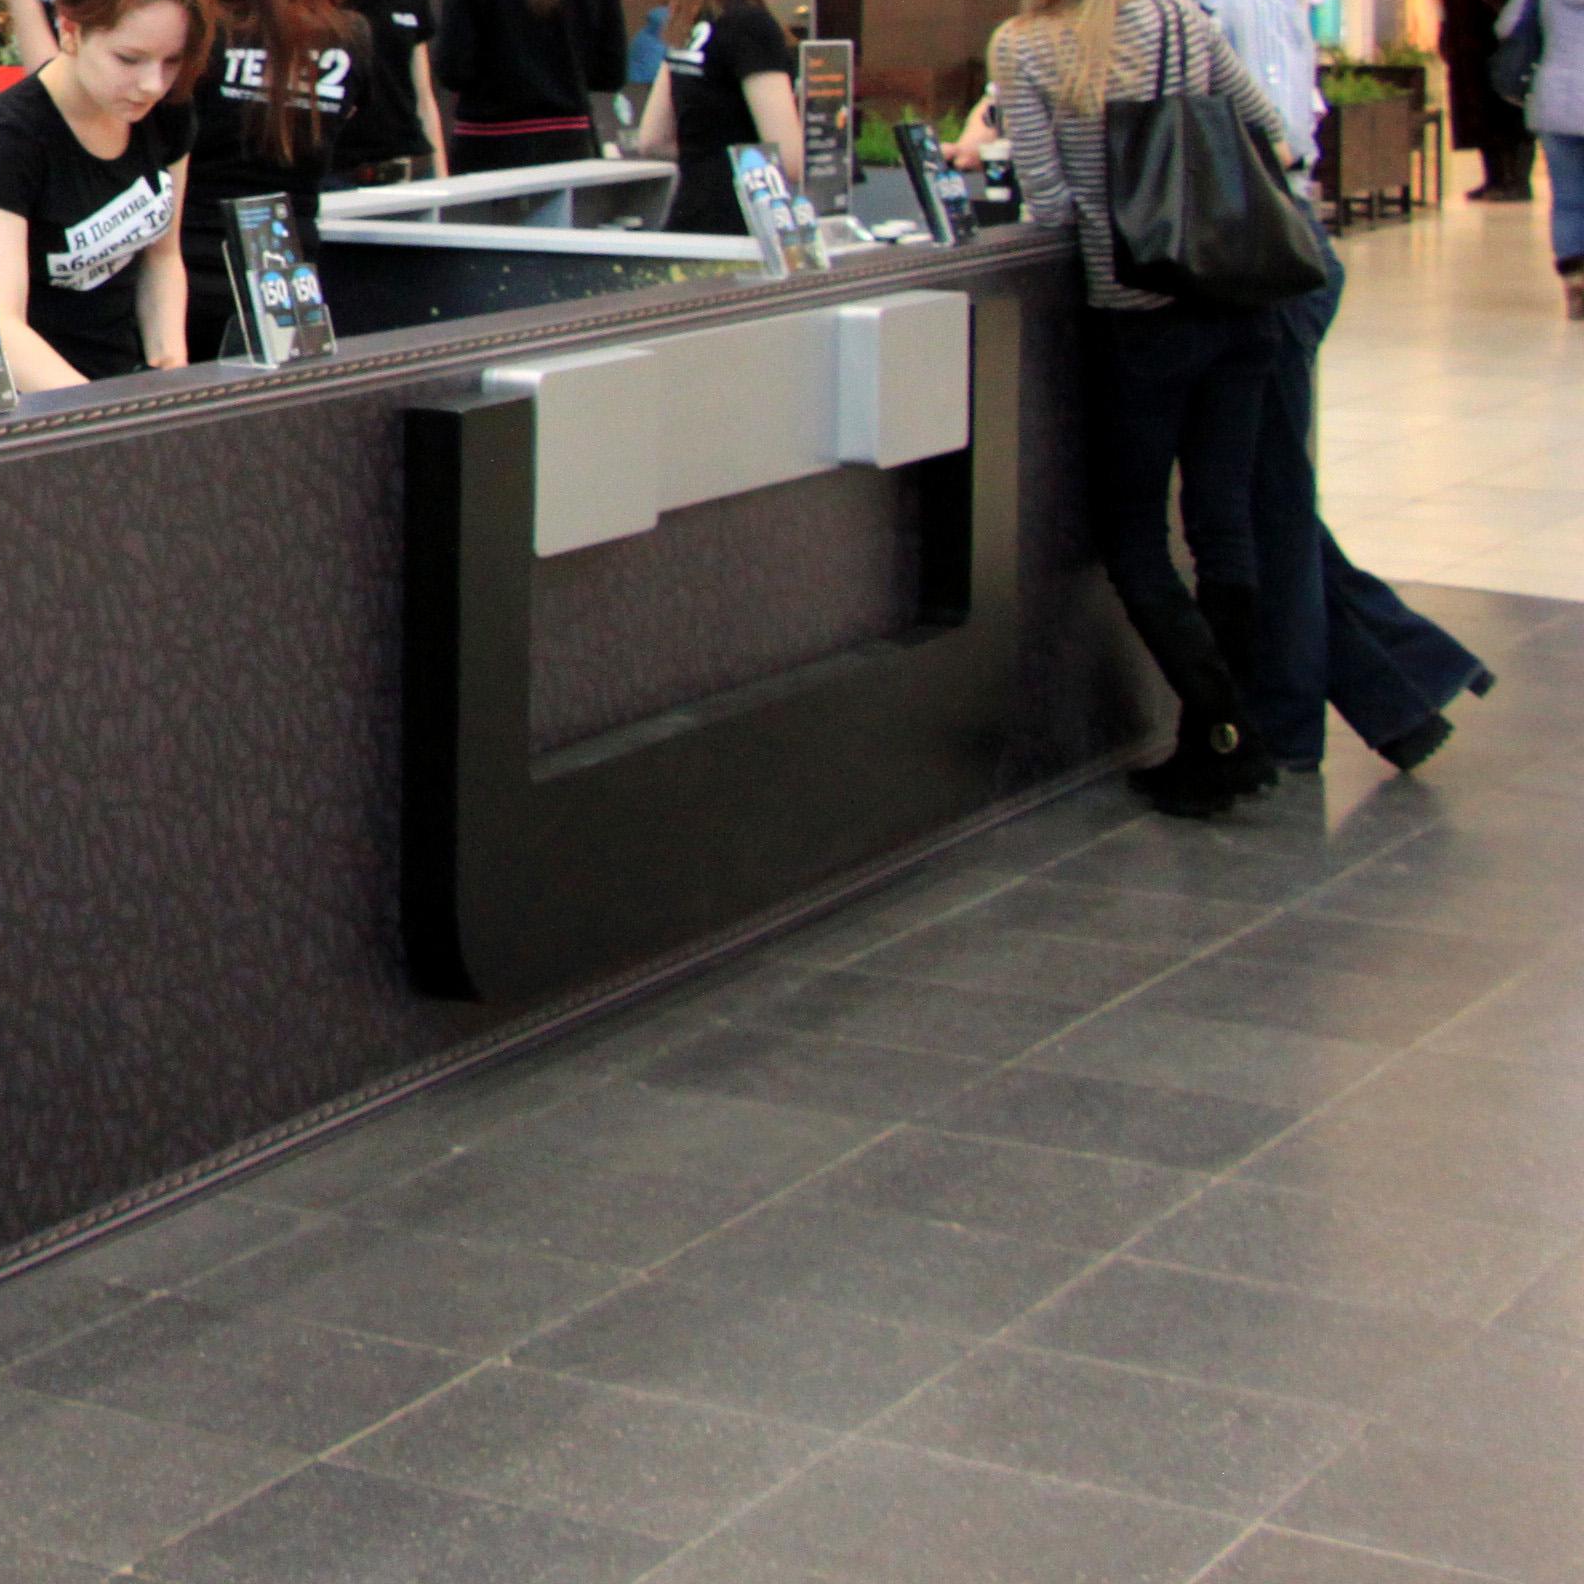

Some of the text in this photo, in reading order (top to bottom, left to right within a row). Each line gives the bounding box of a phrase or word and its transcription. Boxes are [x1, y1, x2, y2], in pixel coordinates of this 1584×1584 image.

[223, 47, 351, 100] TE2
[72, 194, 151, 251] Я Полина
[54, 227, 144, 274] абонент
